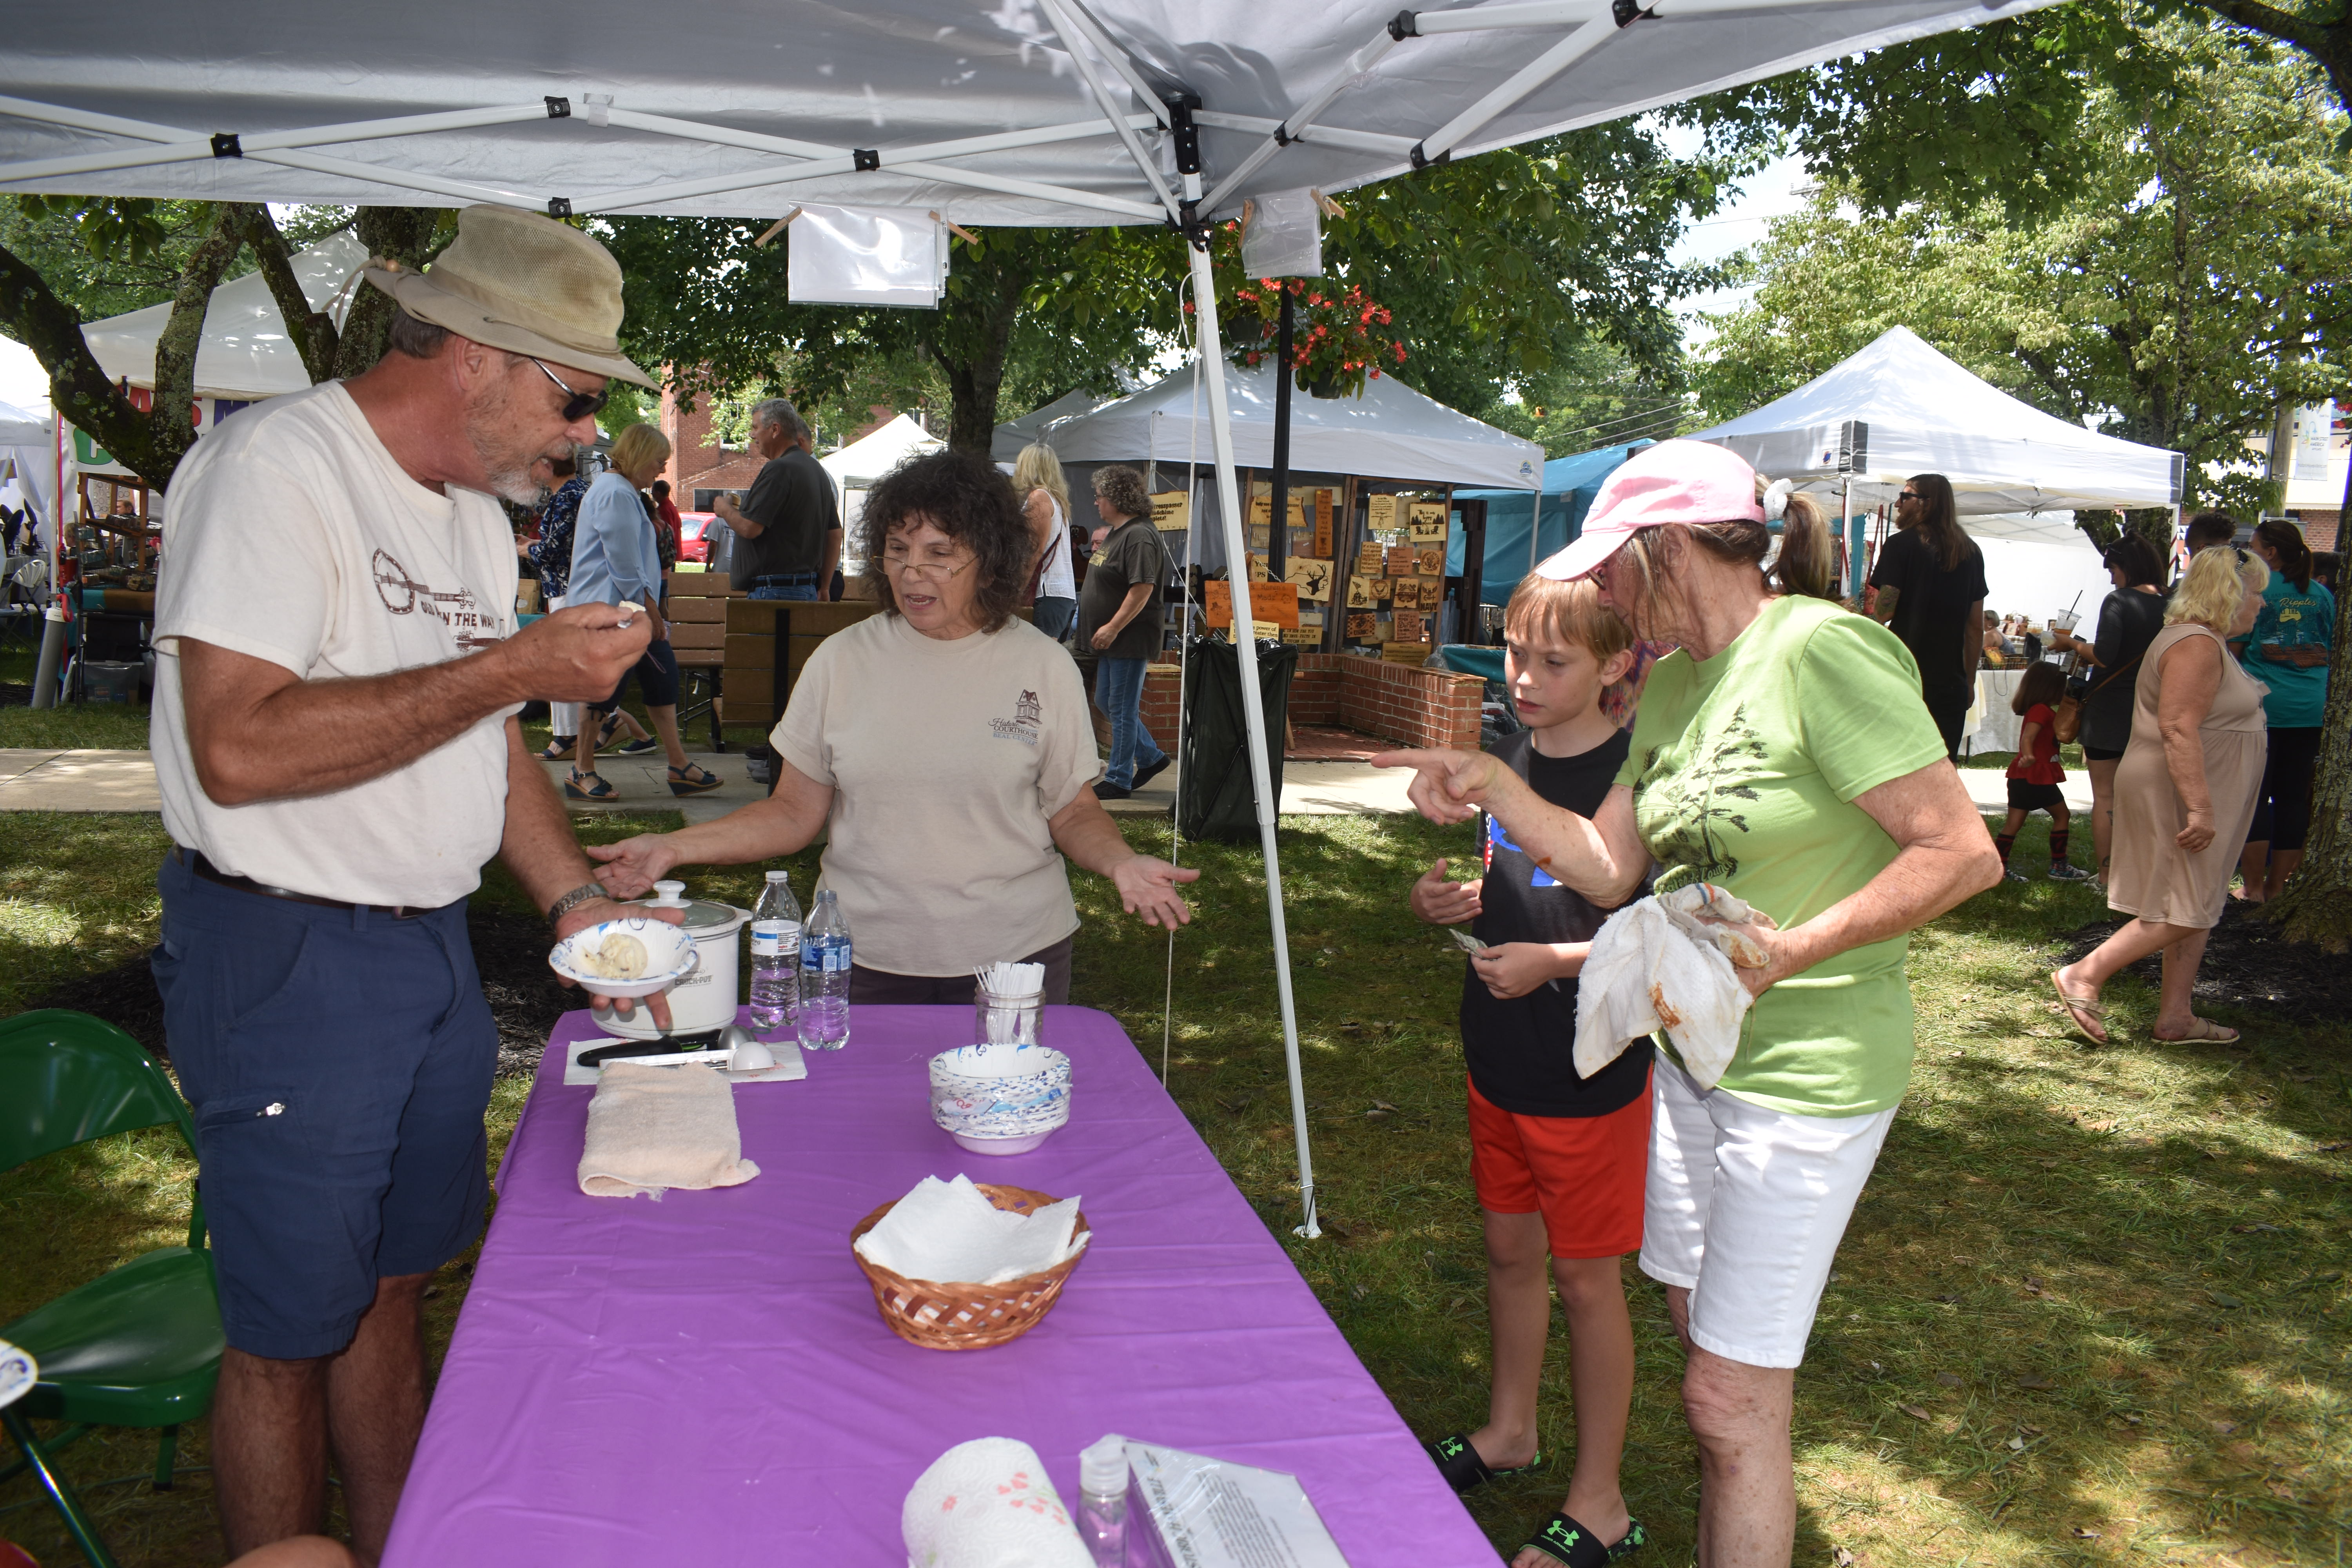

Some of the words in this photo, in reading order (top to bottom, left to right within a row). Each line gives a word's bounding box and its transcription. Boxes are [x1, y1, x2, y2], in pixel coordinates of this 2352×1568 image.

[1421, 603, 1438, 611] NAVY
[2279, 597, 2317, 608] Ripples
[455, 612, 477, 627] THE
[480, 612, 495, 629] WAY
[988, 718, 1020, 727] Historic
[994, 725, 1038, 739] COURTHOUSE
[1013, 735, 1036, 746] CENTER
[1541, 1534, 1553, 1542] UNDER
[1552, 1540, 1570, 1554] ARMOUR
